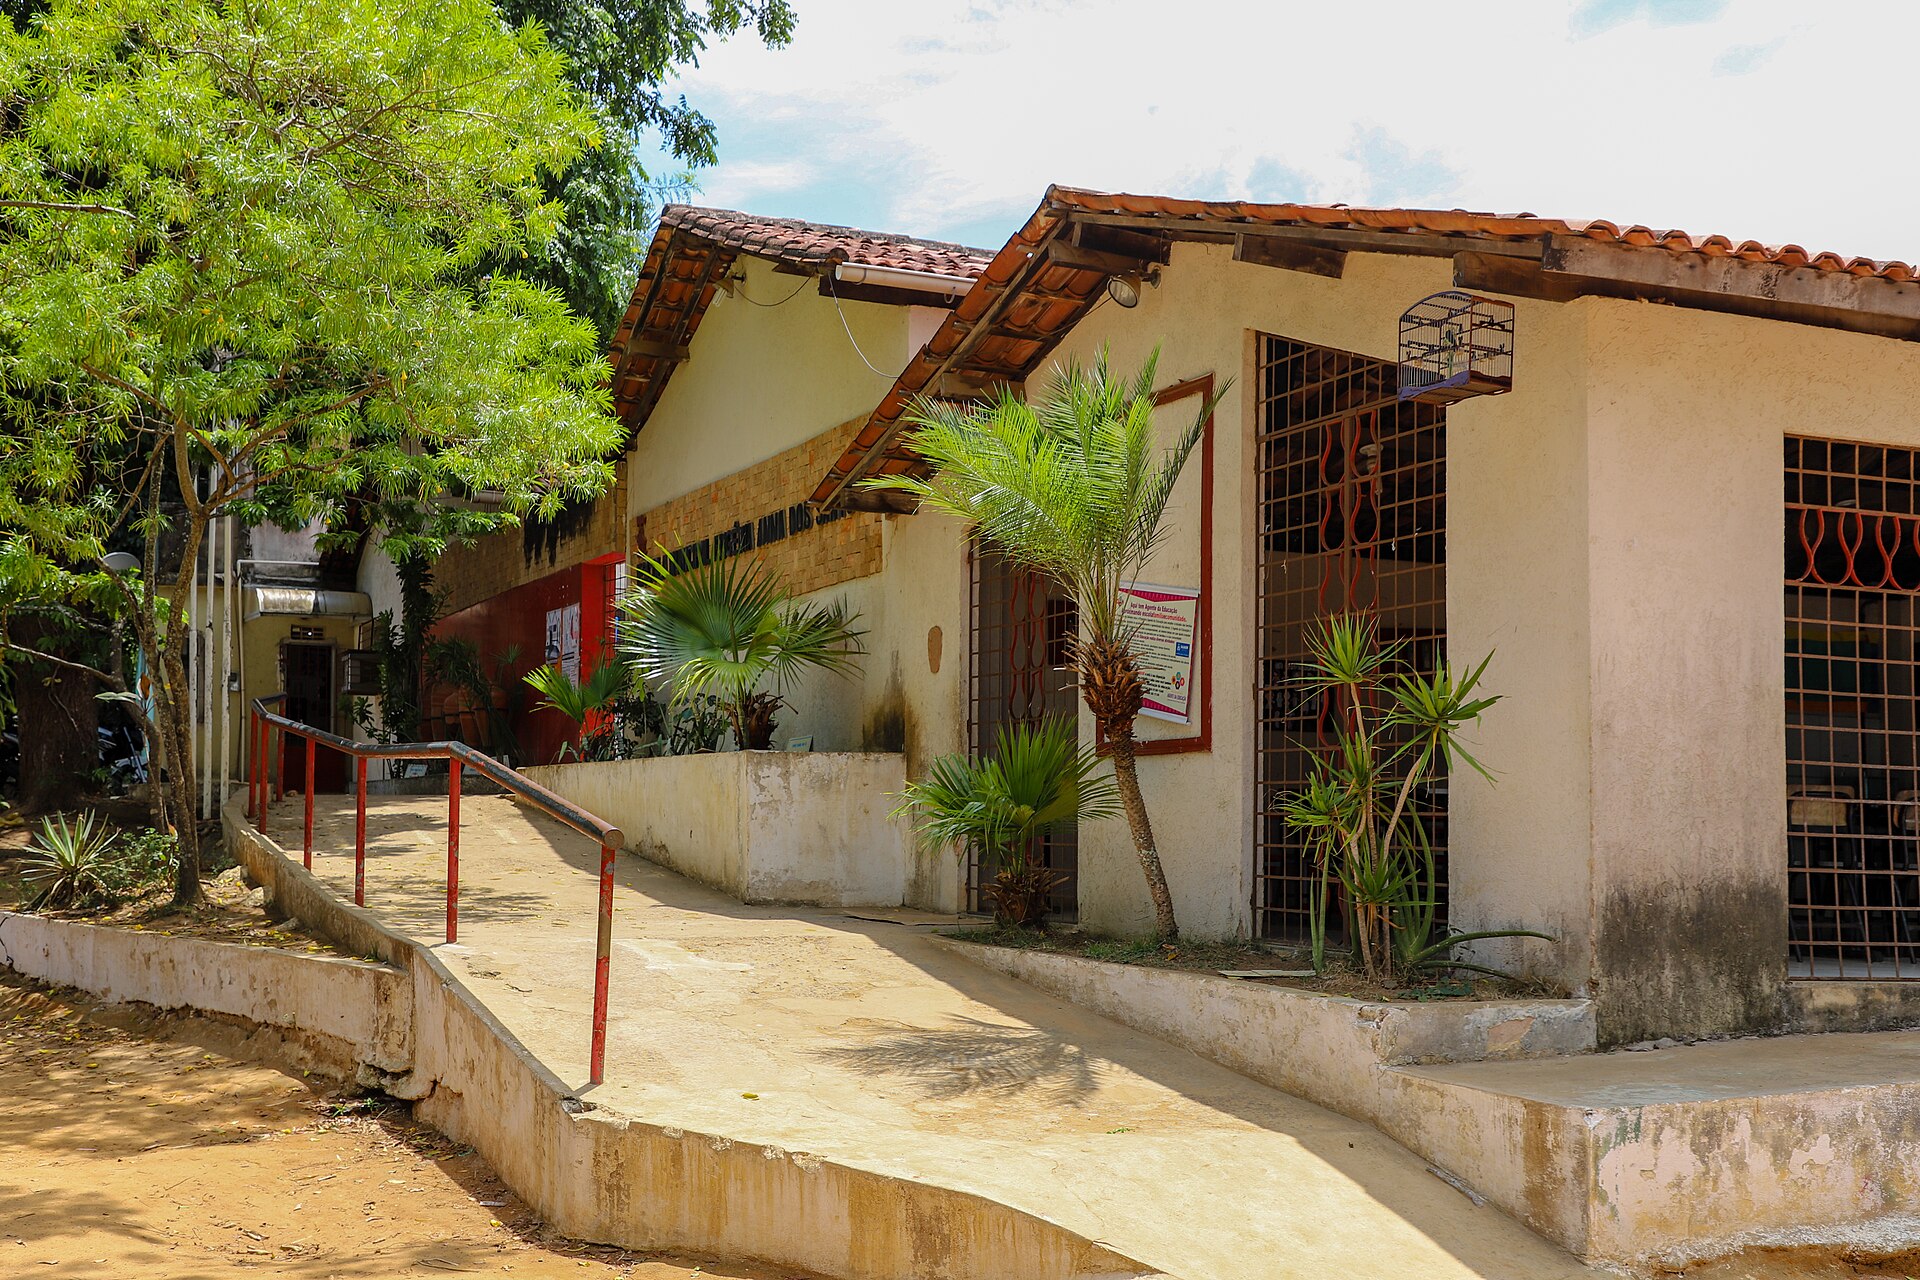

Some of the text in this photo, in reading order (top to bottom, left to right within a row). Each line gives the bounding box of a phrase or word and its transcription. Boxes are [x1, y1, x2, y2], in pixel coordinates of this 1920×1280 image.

[757, 509, 787, 547] ANNA
[1145, 604, 1156, 612] Agente
[1162, 606, 1177, 614] Educação
